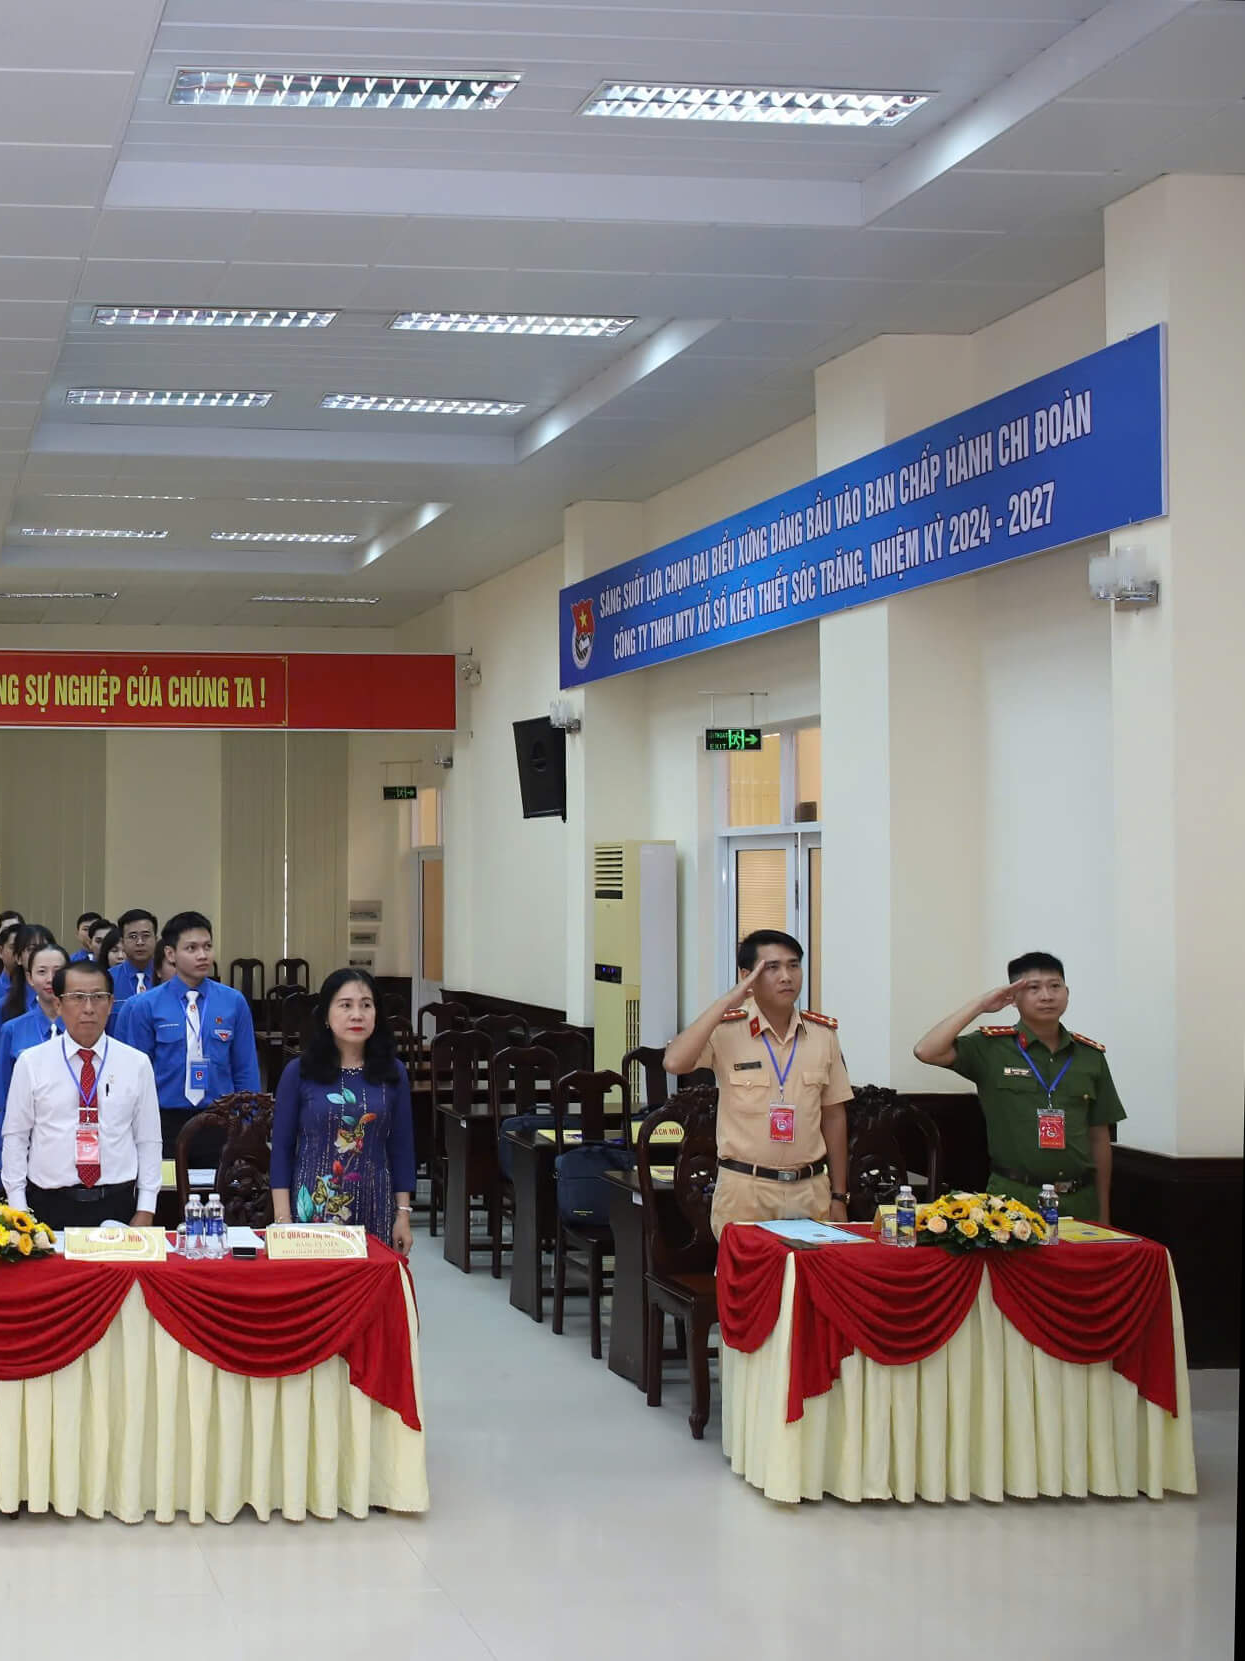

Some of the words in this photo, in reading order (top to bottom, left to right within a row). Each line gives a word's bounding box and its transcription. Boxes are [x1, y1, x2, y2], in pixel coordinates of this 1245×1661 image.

[613, 624, 636, 660] CÔNG
[638, 624, 648, 652] TY
[650, 614, 674, 648] TNHH
[676, 608, 695, 642] MTV
[697, 590, 712, 635] XỔ
[714, 585, 728, 630] SỐ
[730, 578, 755, 624] KIẾN
[758, 565, 788, 616] THIẾT
[792, 561, 816, 604] SÓC
[871, 526, 920, 580] NHIỆM
[924, 512, 944, 563] KỲ
[949, 504, 990, 556] 2024
[1008, 481, 1055, 536] 2027
[623, 568, 644, 610] SUỐT
[646, 568, 663, 607] LỰA
[665, 558, 690, 596] CHỌN
[692, 549, 709, 588] ĐẠI
[712, 530, 735, 577] BIỂU
[770, 509, 803, 556] ĐÁNG
[806, 491, 831, 541] BẦU
[835, 483, 861, 530] VÀO
[865, 472, 895, 519] BAN
[900, 444, 940, 506] CHẤP
[946, 431, 993, 488] HÀNH
[998, 414, 1029, 467] CHI
[1034, 389, 1091, 453] ĐOÀN
[25, 672, 50, 712] SỰ
[55, 669, 120, 713] NGHIỆP
[127, 665, 162, 706] CỦA
[168, 670, 228, 707] CHÚNG
[234, 677, 254, 708] TA
